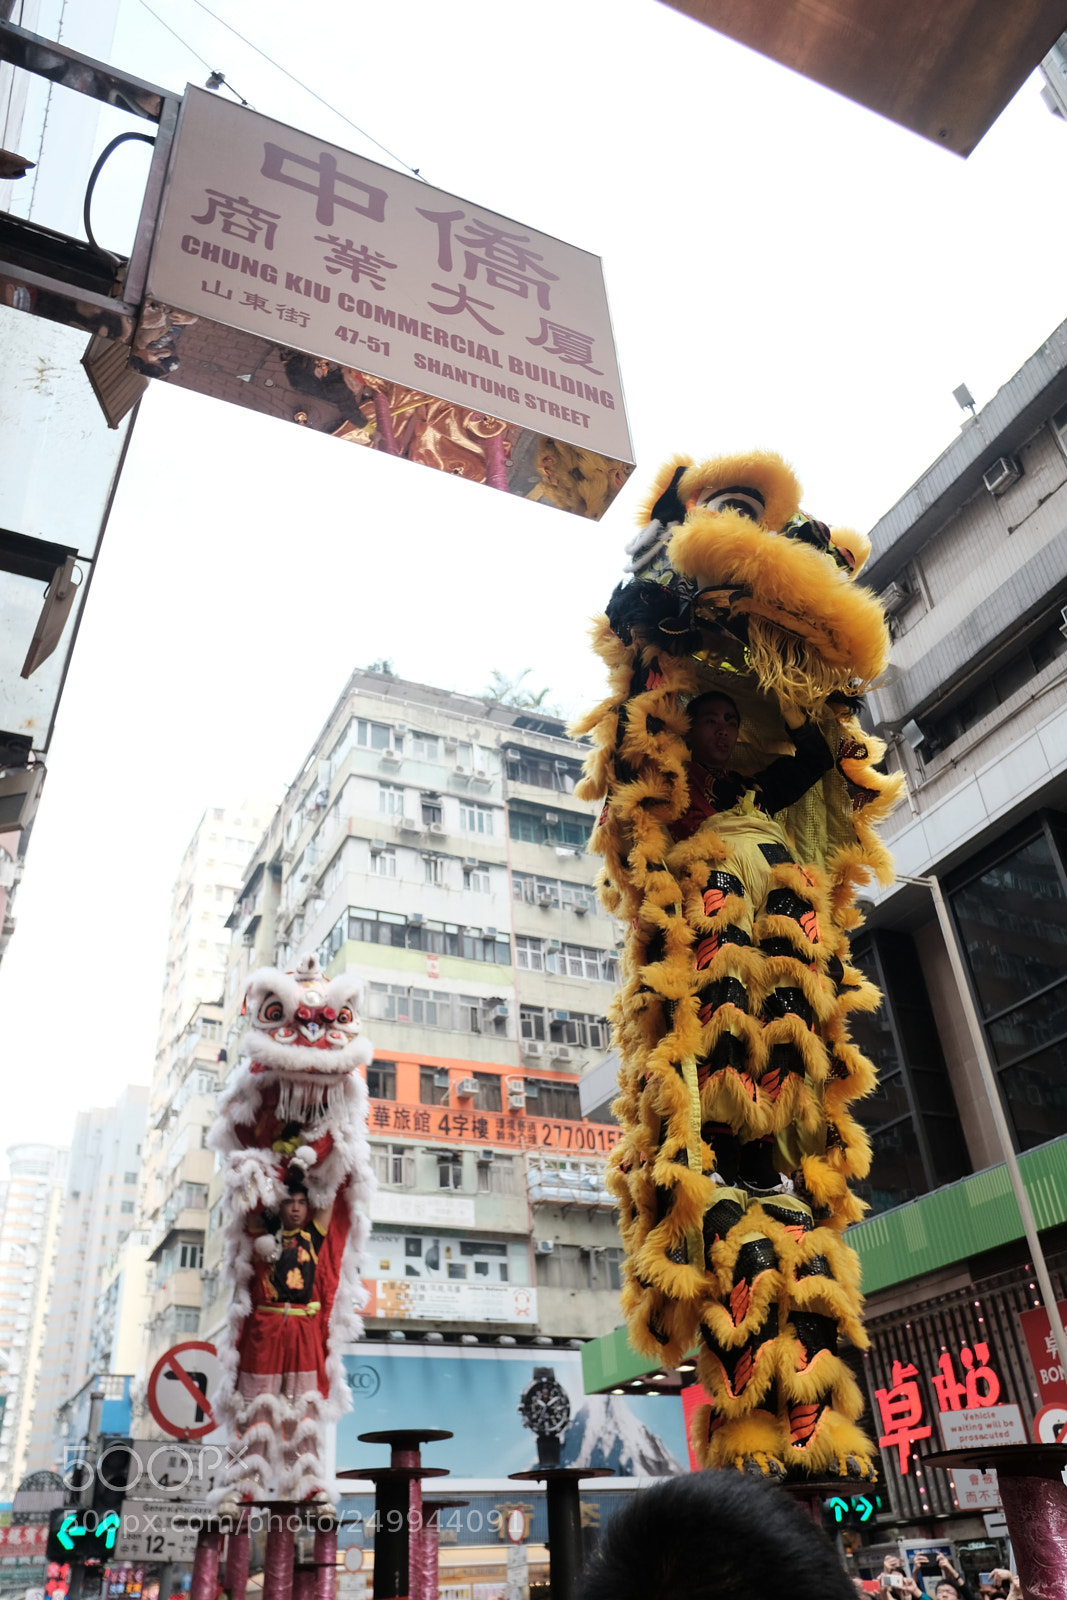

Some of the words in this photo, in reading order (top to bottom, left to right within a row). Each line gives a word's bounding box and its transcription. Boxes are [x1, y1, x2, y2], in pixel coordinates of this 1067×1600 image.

[260, 142, 560, 310] 中僑
[181, 234, 278, 285] CHUNG
[285, 272, 330, 304] KIU
[338, 292, 503, 369] COMMERCIAL
[508, 355, 615, 410] BUILDING
[201, 280, 311, 328] 山東街
[334, 325, 390, 357] 47-51
[413, 353, 520, 404] SHANTUNG
[524, 392, 590, 429] STREET
[366, 1105, 431, 1133] 華旅館
[951, 1423, 983, 1432] waiting
[985, 1420, 1002, 1429] will
[1003, 1420, 1014, 1428] be
[963, 1411, 996, 1421] Vehicle
[959, 1430, 1010, 1443] prosecuted
